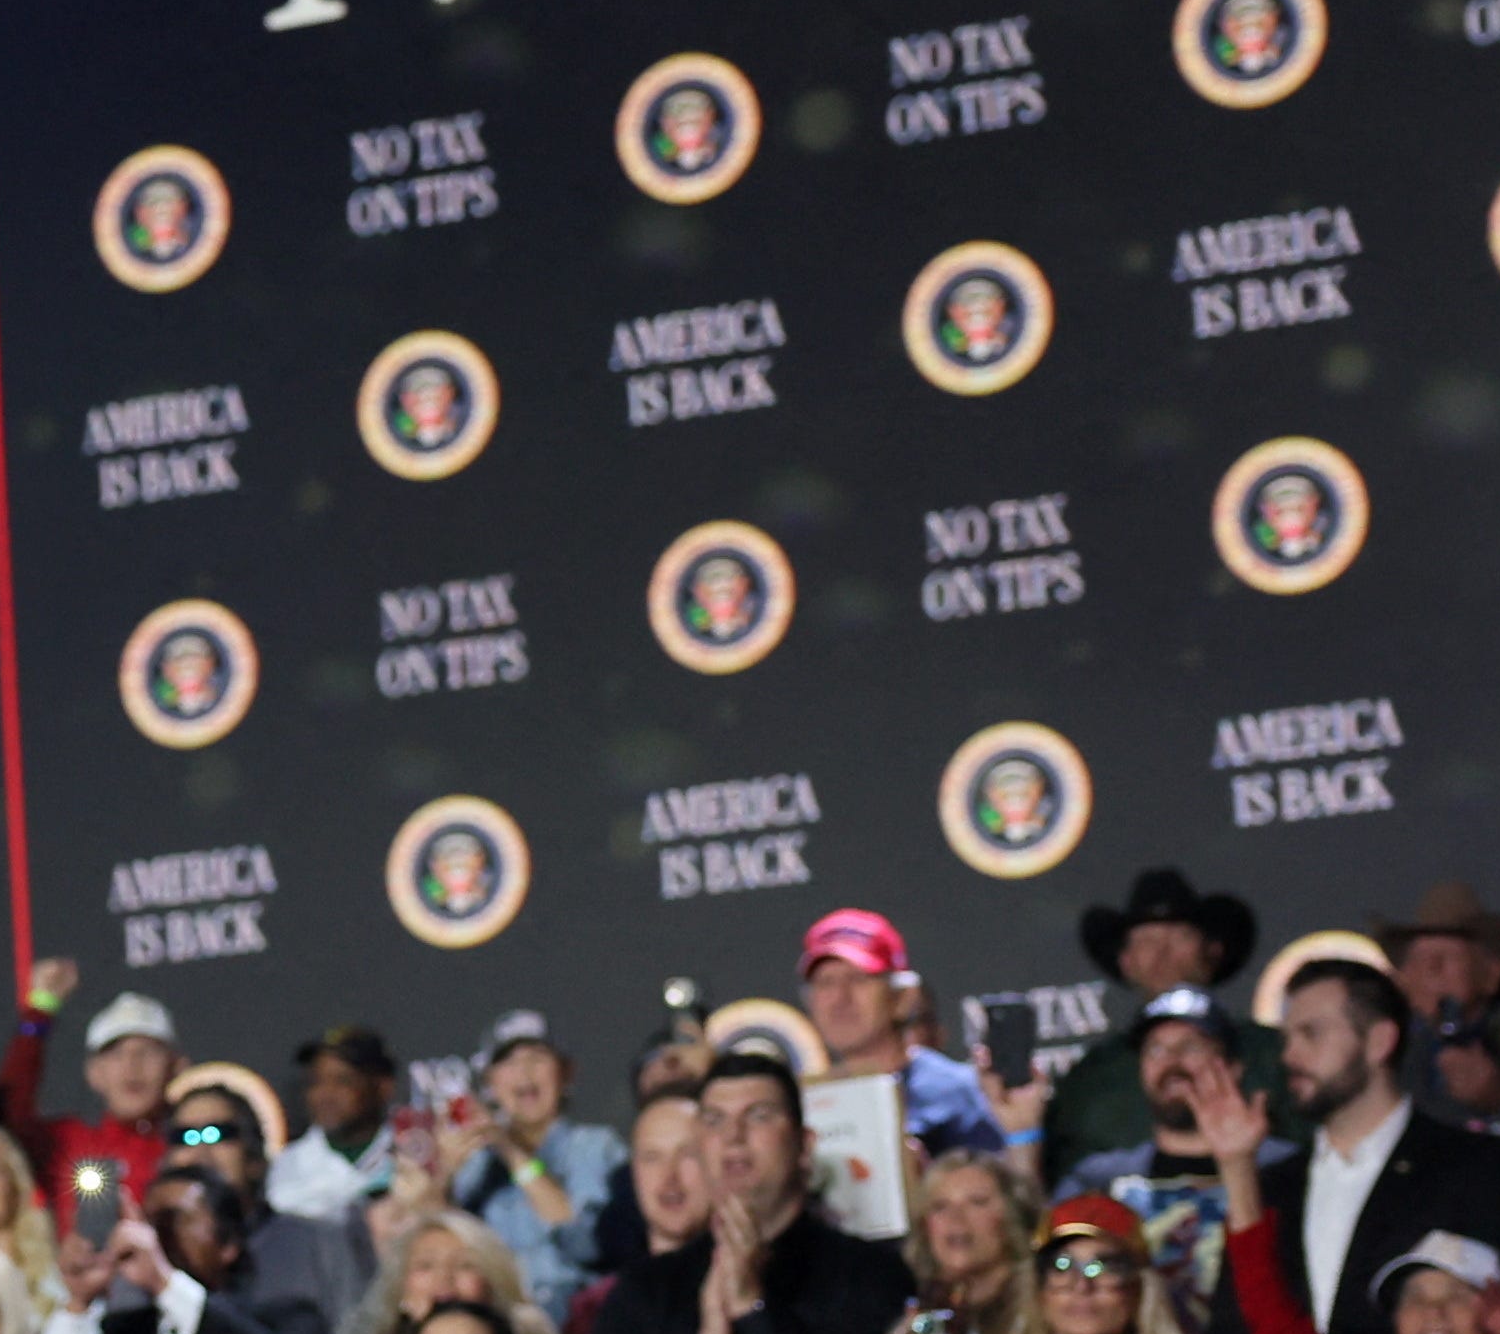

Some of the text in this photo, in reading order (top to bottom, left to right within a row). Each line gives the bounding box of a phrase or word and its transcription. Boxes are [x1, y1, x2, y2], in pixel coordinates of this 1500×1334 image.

[888, 16, 1032, 84] NO TAX
[884, 72, 1046, 144] ON TIPS
[349, 113, 486, 180] NO TAX
[345, 167, 498, 237] ON TIPS
[1173, 207, 1361, 281] AMERICA
[610, 300, 786, 370] AMERICA
[1190, 265, 1351, 340] IS BACK
[84, 386, 248, 454] AMERICA
[626, 356, 776, 427] IS BACK
[98, 441, 239, 509] IS BACK
[923, 494, 1070, 563] NO TAX
[379, 576, 517, 640] NO TAX
[920, 550, 1084, 622] ON TIPS
[374, 630, 529, 698] ON TIPS
[1212, 698, 1403, 769] AMERICA
[640, 774, 820, 843] AMERICA
[1230, 757, 1393, 828] IS BACK
[110, 845, 277, 912] AMERICA
[658, 832, 810, 900] IS BACK
[123, 901, 266, 968] IS BACK
[1024, 980, 1109, 1041] TAX
